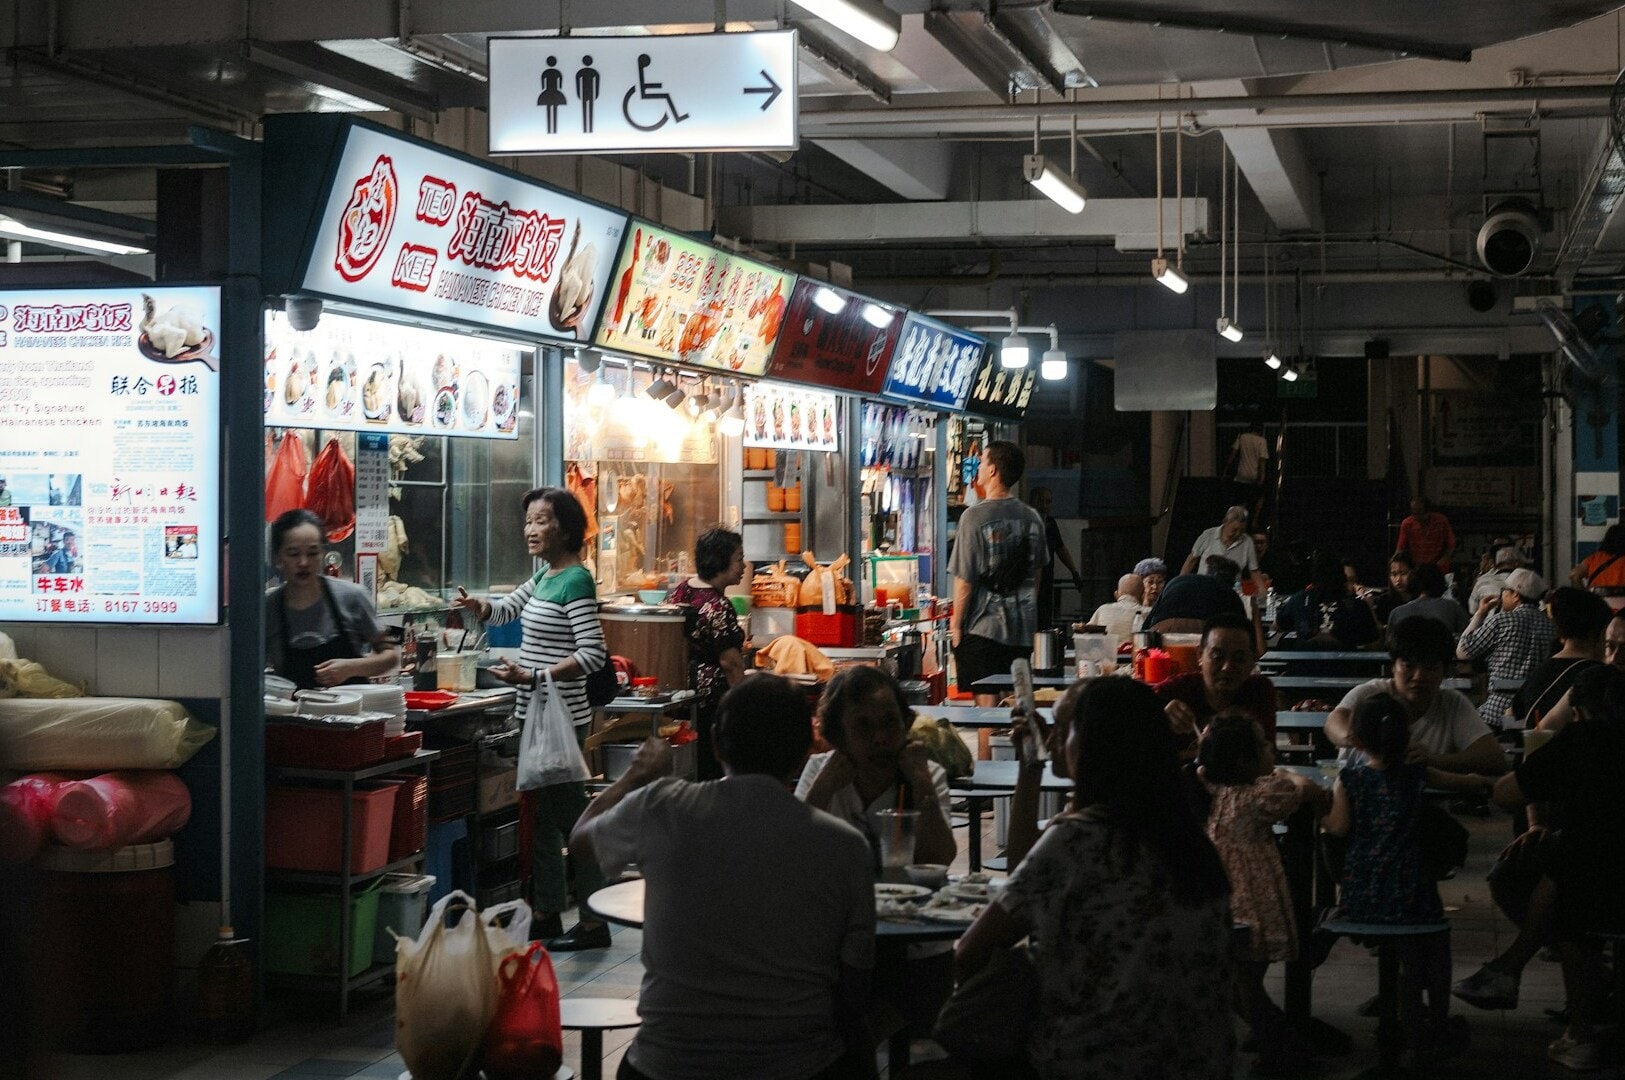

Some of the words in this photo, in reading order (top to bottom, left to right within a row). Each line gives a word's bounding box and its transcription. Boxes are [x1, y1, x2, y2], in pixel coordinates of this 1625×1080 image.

[417, 177, 456, 224] TEO
[448, 193, 565, 281] 海南鸡饭
[393, 246, 437, 289] KEE
[434, 270, 490, 306] HAINANESE
[522, 290, 544, 316] RICE
[14, 303, 132, 332] 海南鸡饭
[110, 375, 199, 396] 联合早报
[14, 404, 30, 415] Try
[34, 404, 85, 415] Signature
[1, 418, 56, 427] Hainanese
[60, 418, 102, 427] chicken
[37, 576, 84, 593] 牛车水
[105, 600, 138, 612] 8167
[143, 601, 178, 612] 3999
